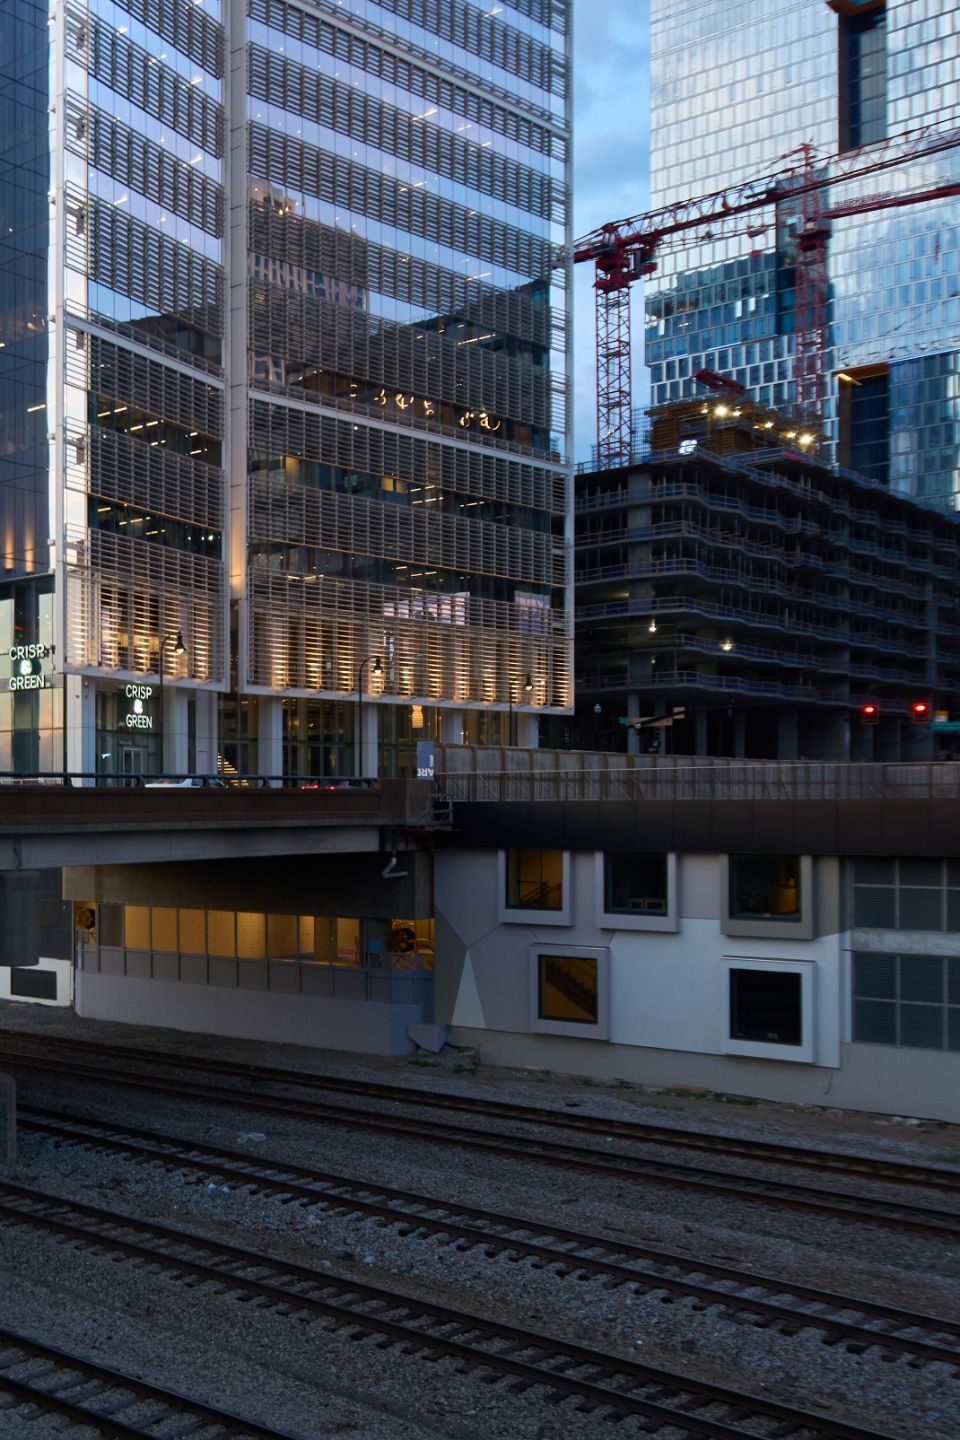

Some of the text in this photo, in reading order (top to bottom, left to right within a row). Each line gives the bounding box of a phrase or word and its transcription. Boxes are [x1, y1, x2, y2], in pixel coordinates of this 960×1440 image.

[10, 643, 45, 660] CRISP
[10, 675, 45, 691] GREEN
[125, 684, 152, 699] CRISP
[125, 714, 153, 728] GREEN
